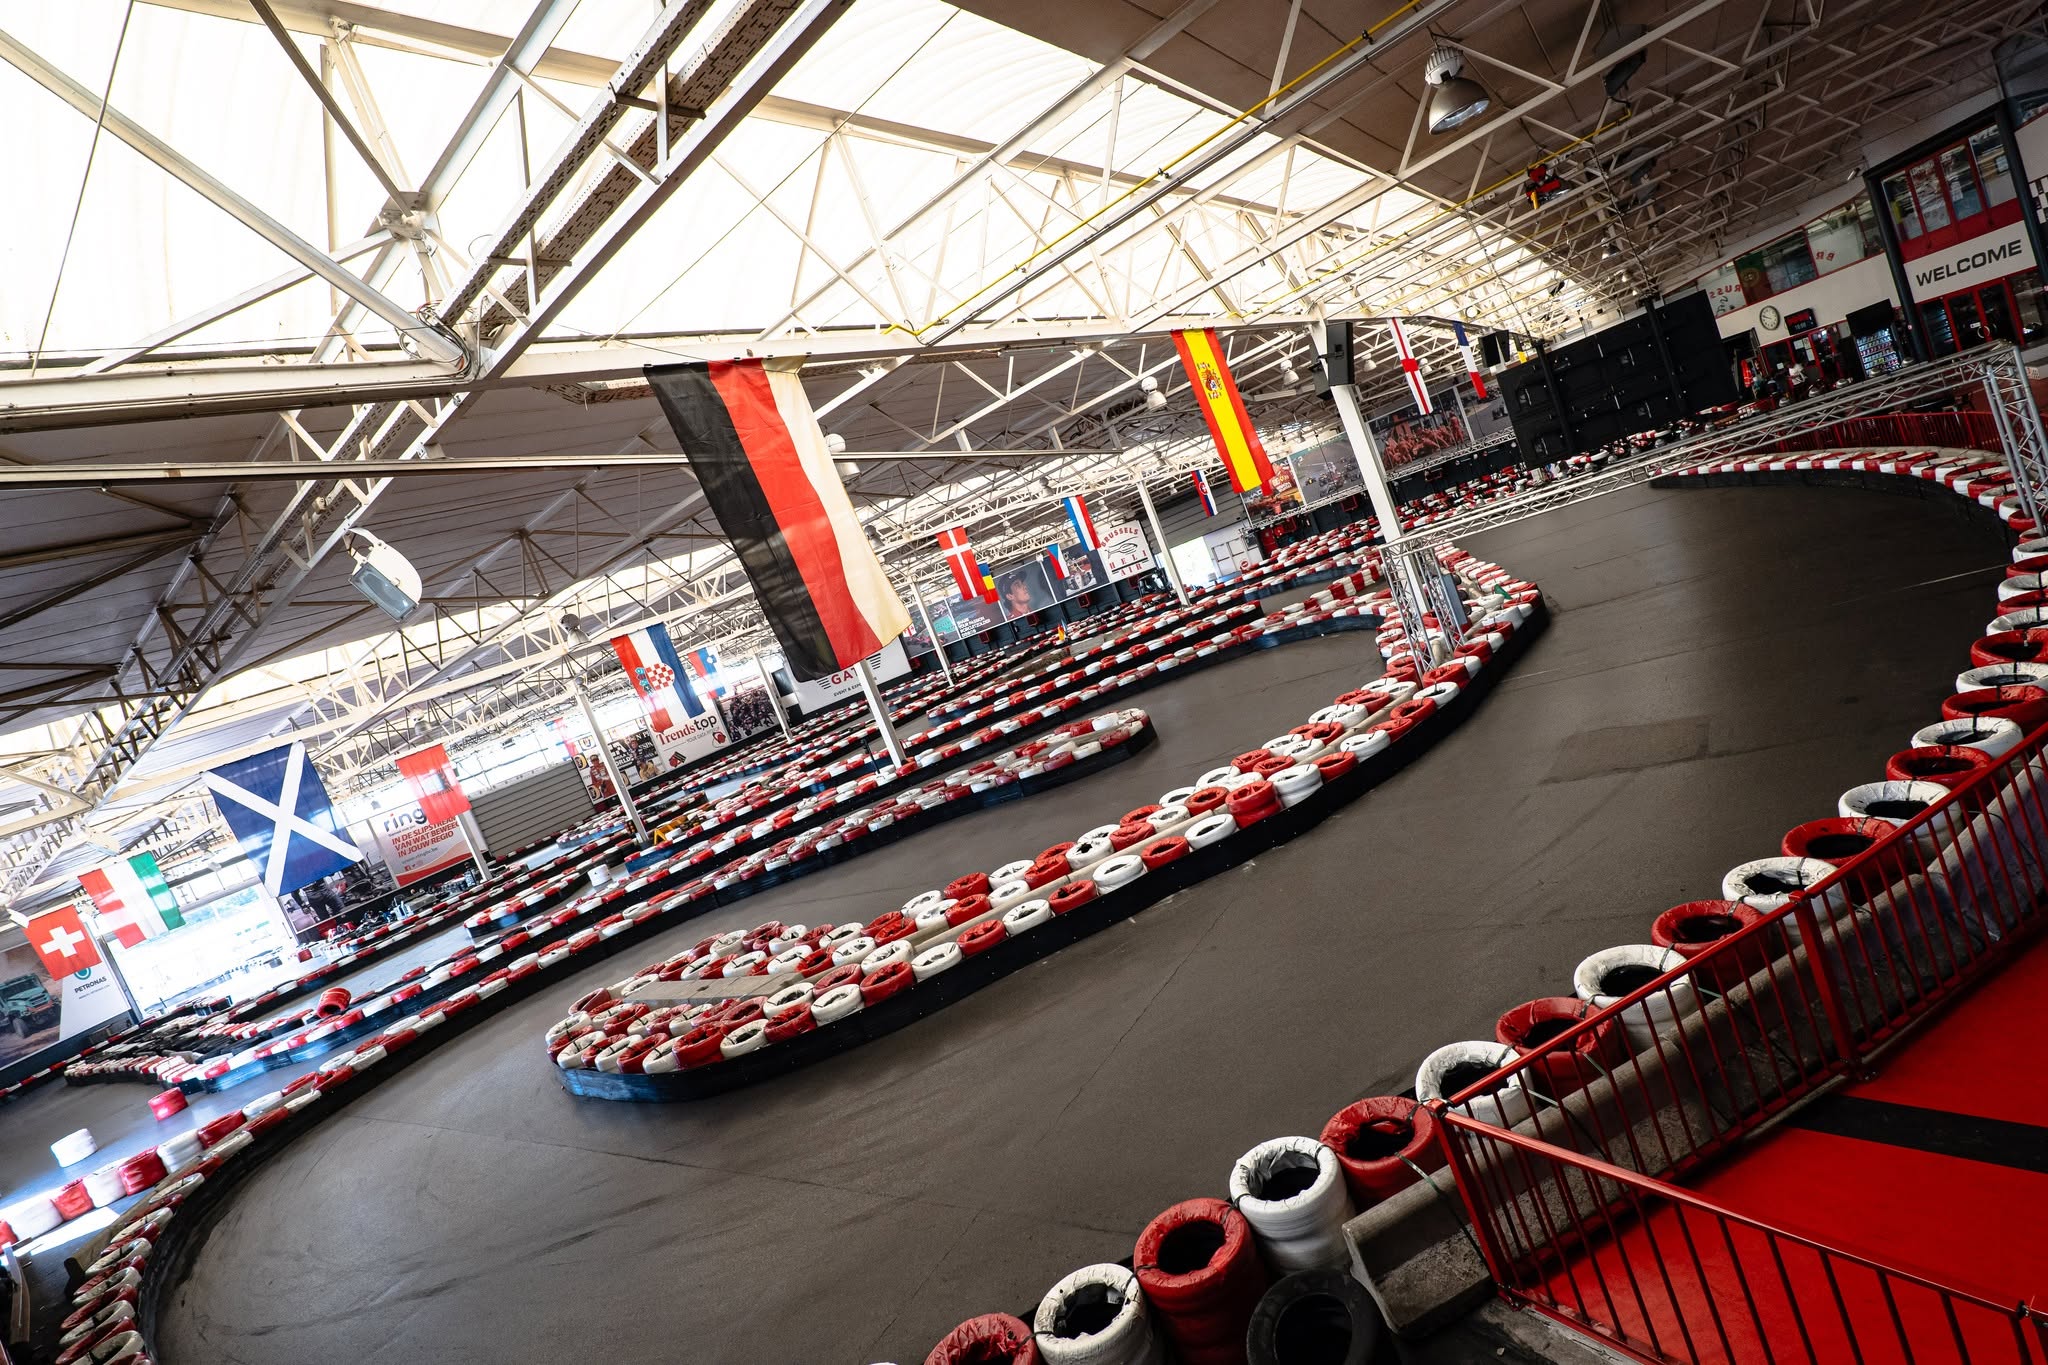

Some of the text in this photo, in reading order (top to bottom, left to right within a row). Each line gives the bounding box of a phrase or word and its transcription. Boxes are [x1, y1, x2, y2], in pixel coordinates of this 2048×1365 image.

[1915, 239, 2023, 287] WELCOME
[1109, 550, 1147, 570] HELI
[1120, 563, 1143, 577] AIR
[831, 667, 857, 685] GAT
[383, 808, 428, 833] ring
[391, 836, 401, 846] IN
[401, 832, 413, 842] DE
[394, 840, 412, 852] VAN
[412, 833, 430, 845] WAT
[398, 832, 454, 858] IN JOUW REGIO
[74, 976, 107, 993] PETRONAS
